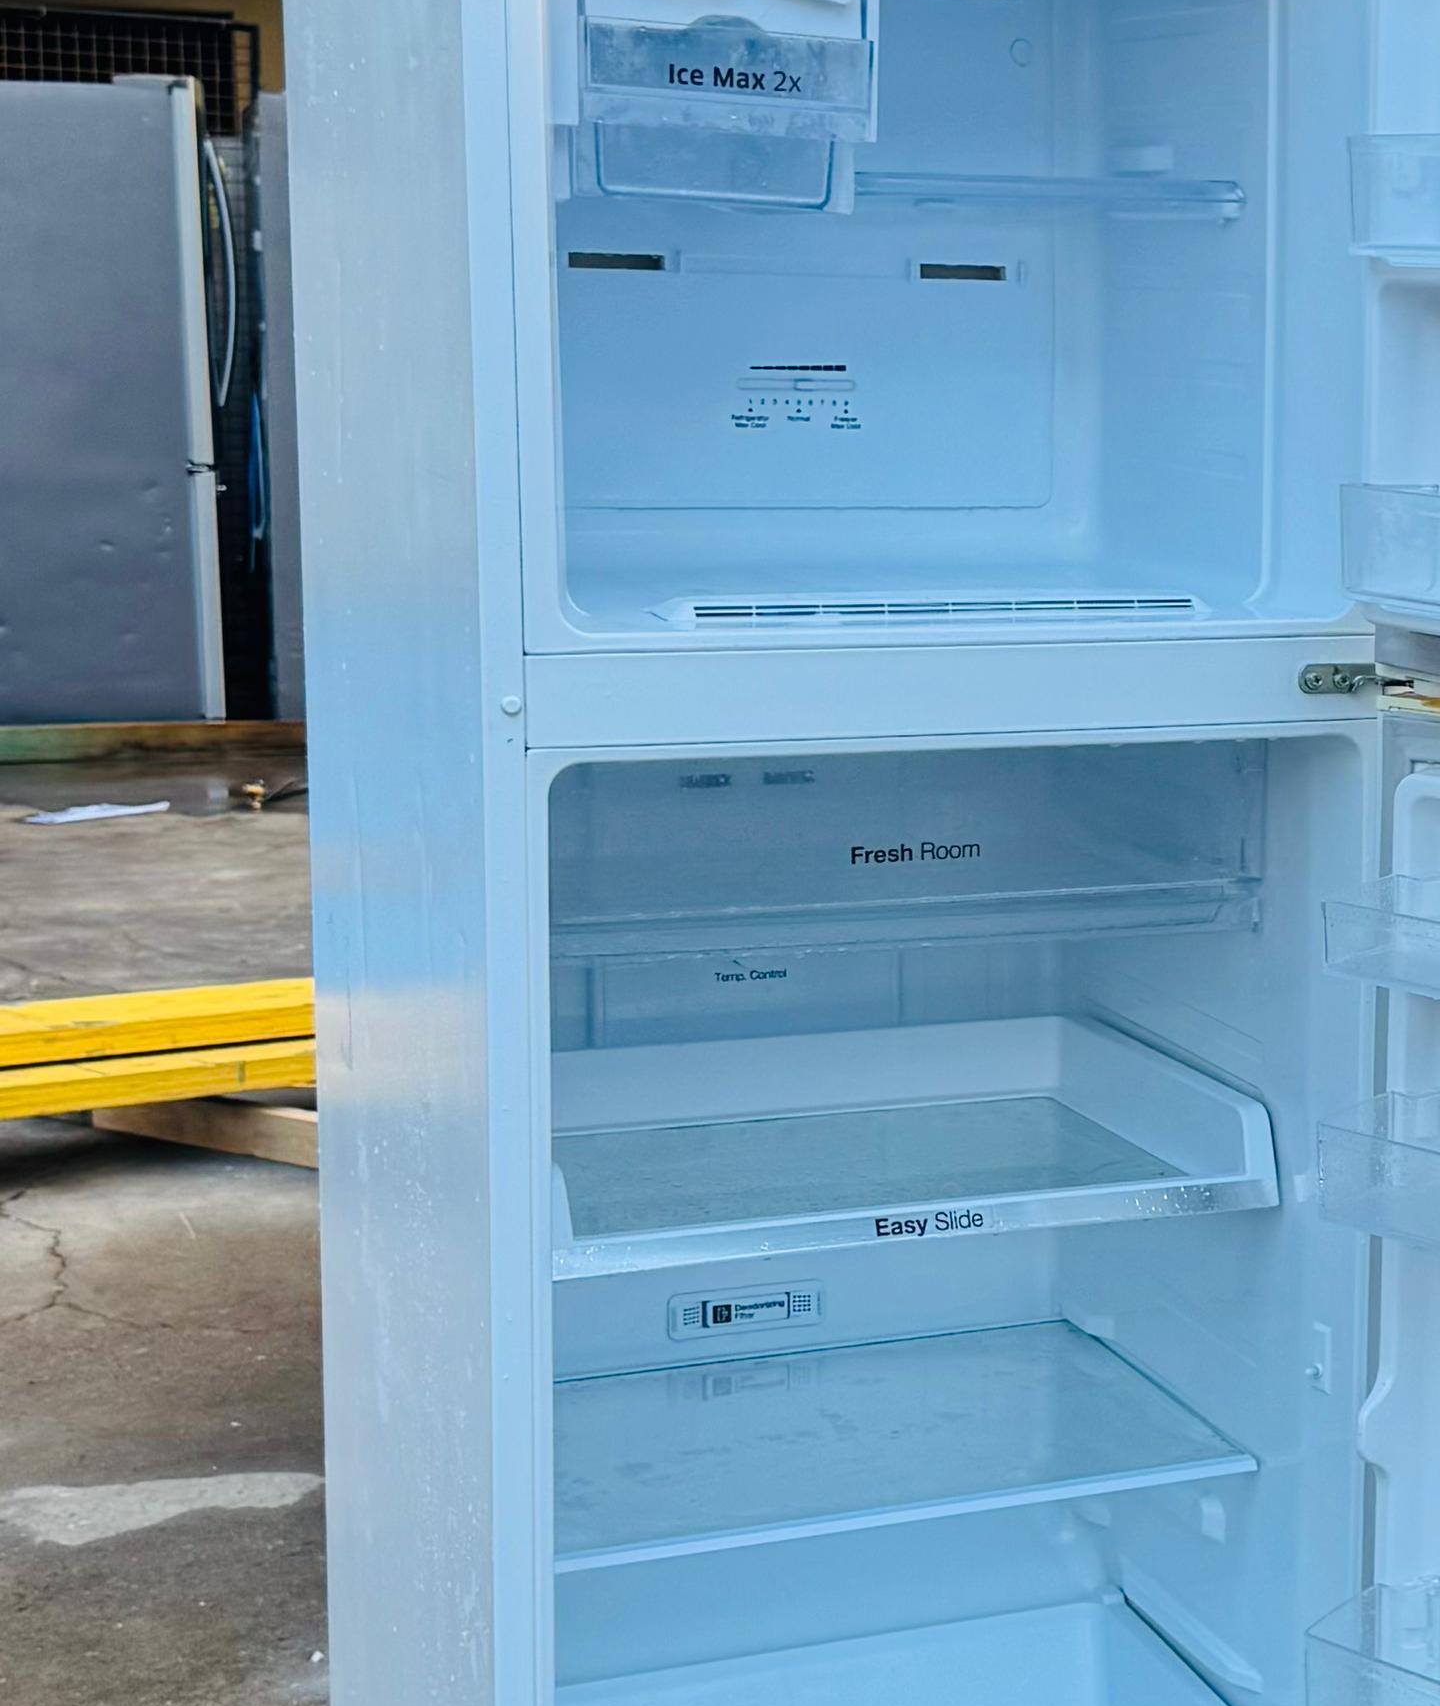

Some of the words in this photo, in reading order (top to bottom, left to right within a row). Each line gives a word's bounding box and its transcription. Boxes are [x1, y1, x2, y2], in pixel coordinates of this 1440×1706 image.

[668, 63, 705, 87] Ice
[713, 65, 766, 91] Max
[772, 70, 802, 93] 2x
[850, 843, 914, 865] Fresh
[920, 841, 981, 861] Room
[749, 968, 788, 981] Control
[874, 1217, 929, 1238] Easy
[934, 1208, 984, 1231] Slide
